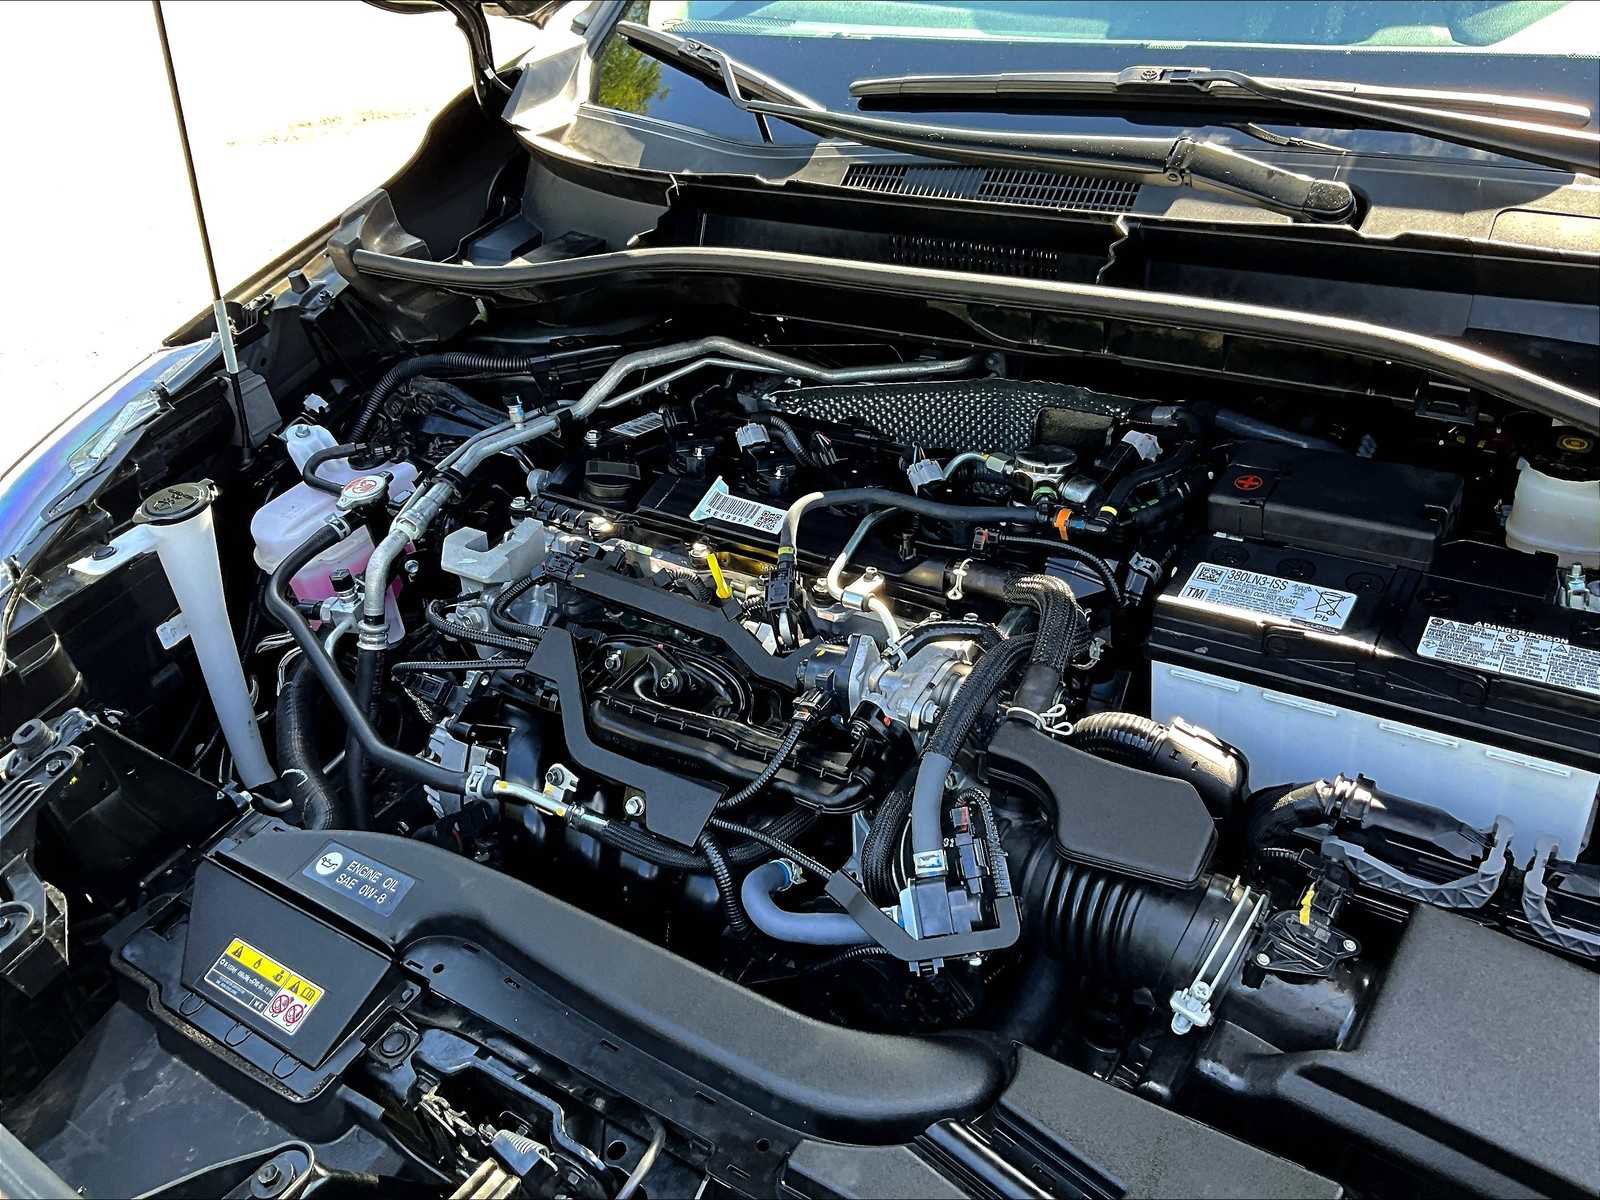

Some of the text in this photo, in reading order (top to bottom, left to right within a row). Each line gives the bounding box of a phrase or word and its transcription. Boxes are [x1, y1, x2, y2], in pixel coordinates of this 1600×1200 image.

[1227, 569, 1289, 590] 380LN3-ISS
[1186, 587, 1205, 599] TM
[1313, 613, 1329, 622] Pb
[1484, 622, 1569, 644] DANGER/POISON
[346, 860, 399, 892] ENGINE OIL
[336, 873, 387, 904] SAE 0W-8
